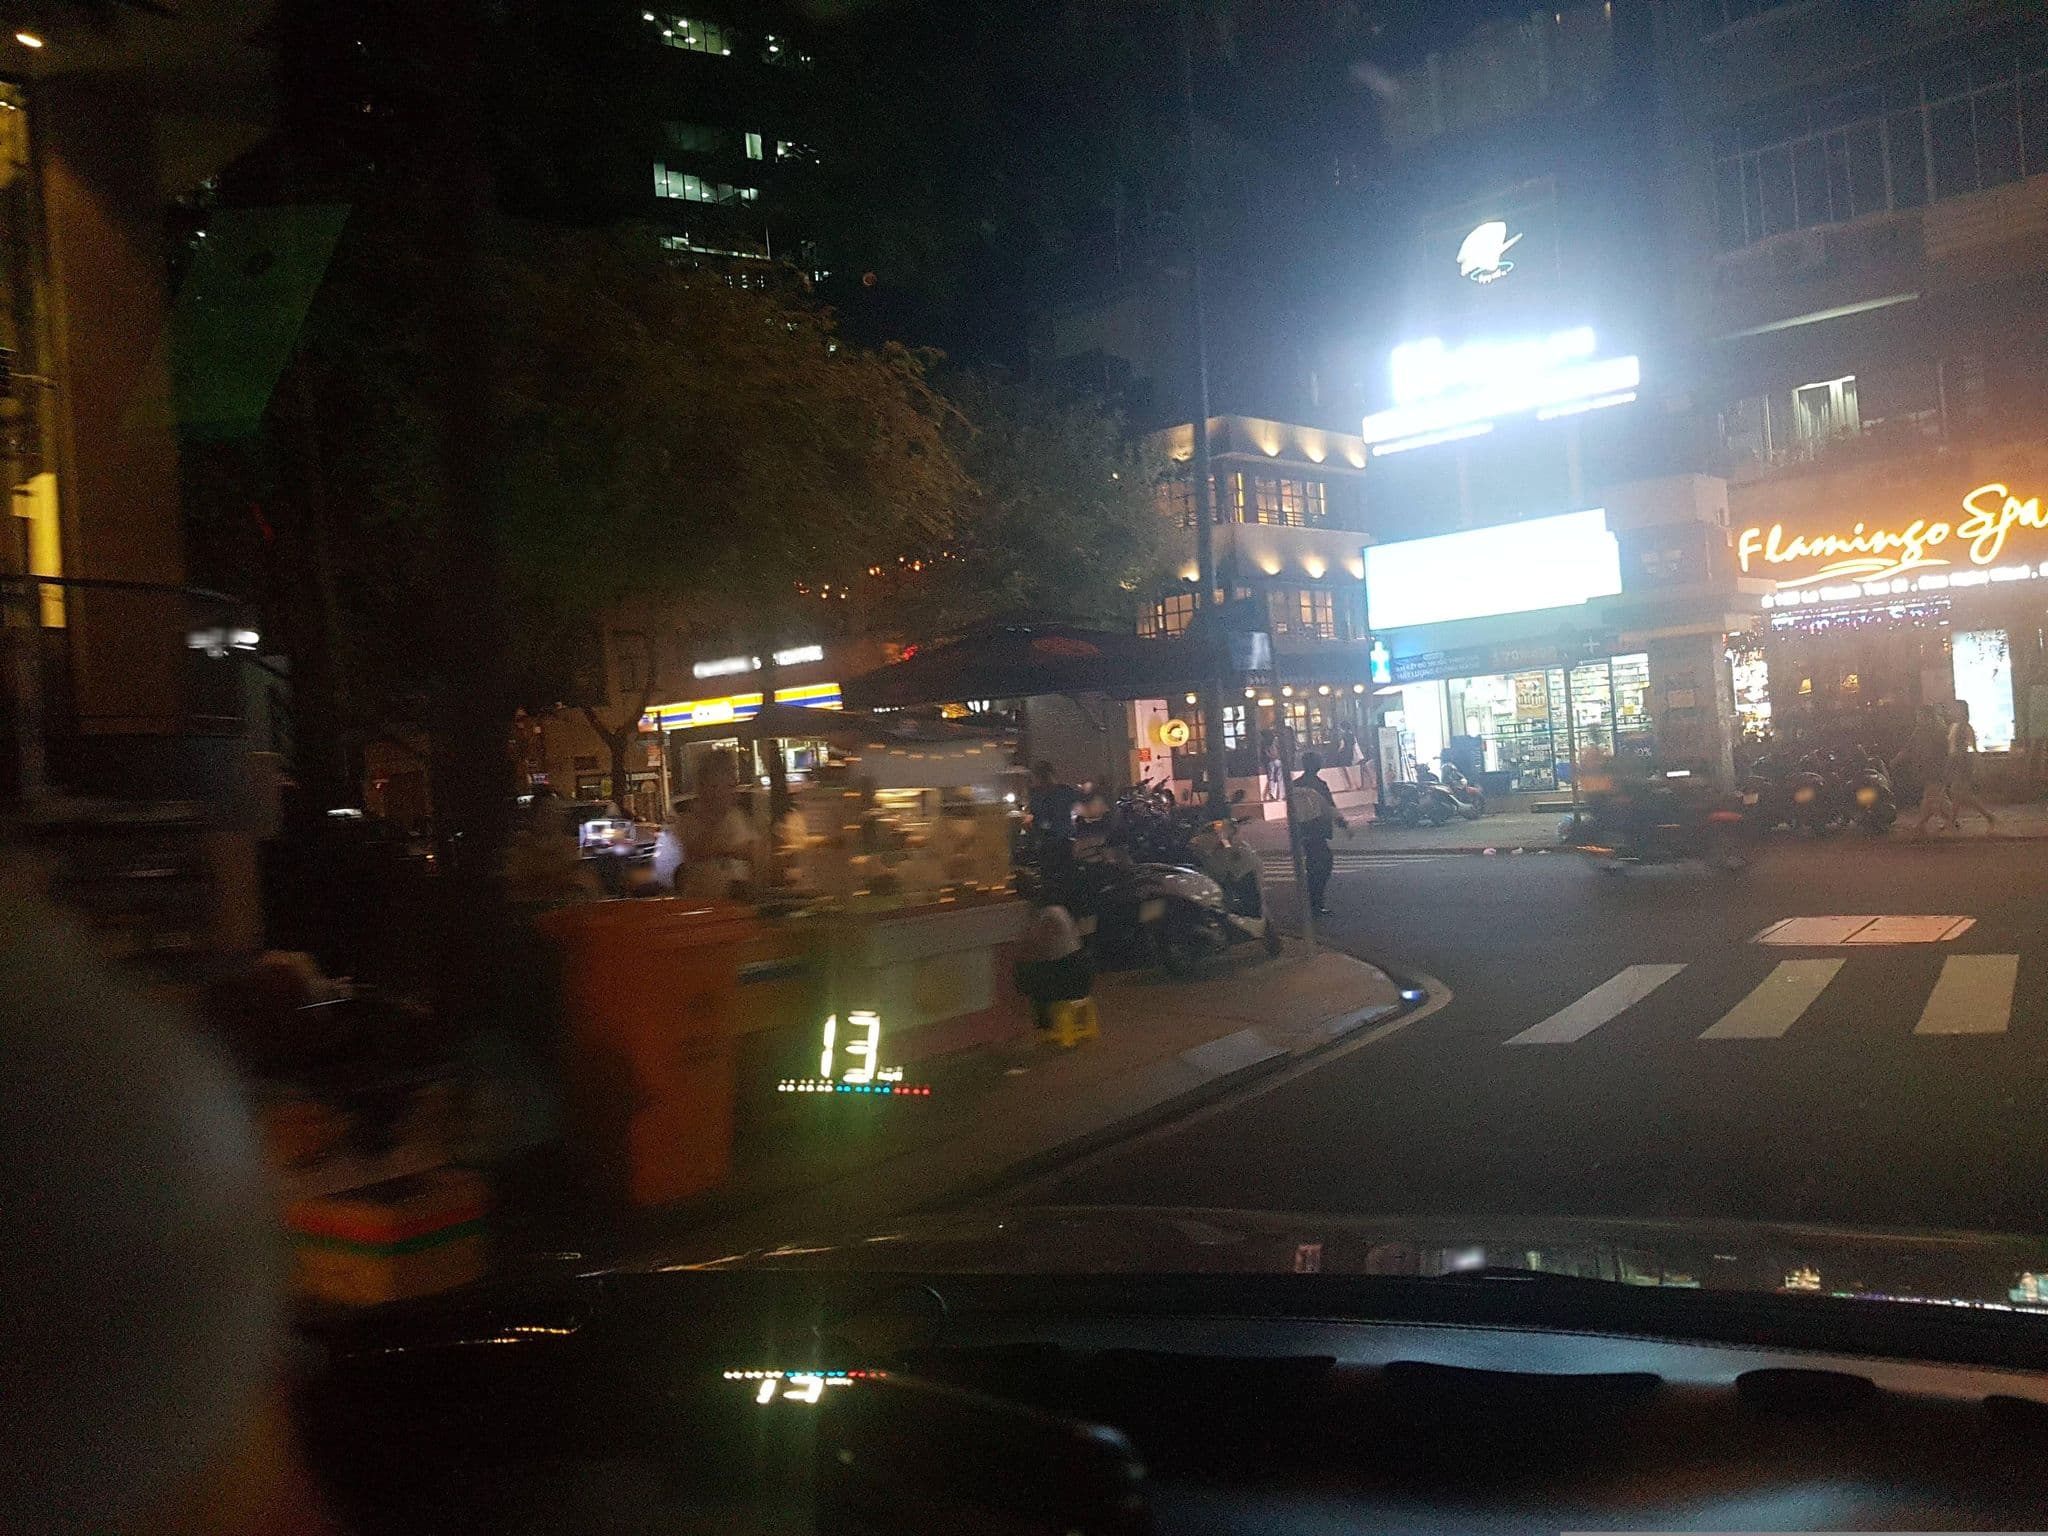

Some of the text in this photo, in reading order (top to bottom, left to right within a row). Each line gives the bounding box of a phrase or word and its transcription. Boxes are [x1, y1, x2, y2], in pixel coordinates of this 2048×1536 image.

[1738, 483, 2048, 574] Flamingo Spa
[820, 1010, 881, 1083] 13
